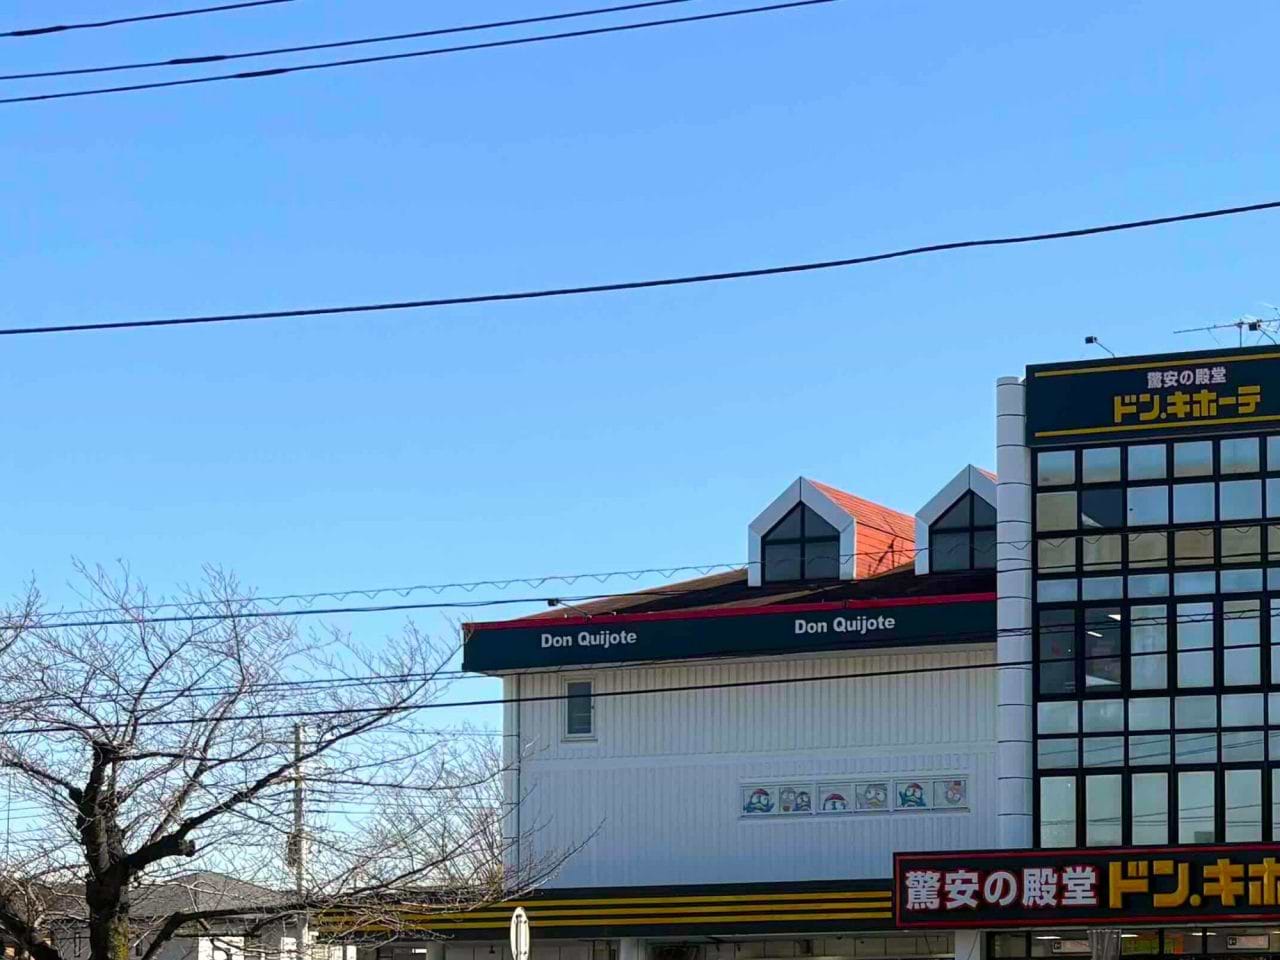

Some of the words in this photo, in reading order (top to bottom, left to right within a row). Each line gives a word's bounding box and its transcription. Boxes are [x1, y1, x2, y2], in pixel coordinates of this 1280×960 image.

[1147, 366, 1227, 388] 驚安の殿堂
[794, 618, 828, 635] Don
[832, 615, 896, 635] Quijote
[541, 633, 573, 648] Don
[577, 629, 638, 648] Quijote
[904, 865, 1097, 911] 驚安の殿堂
